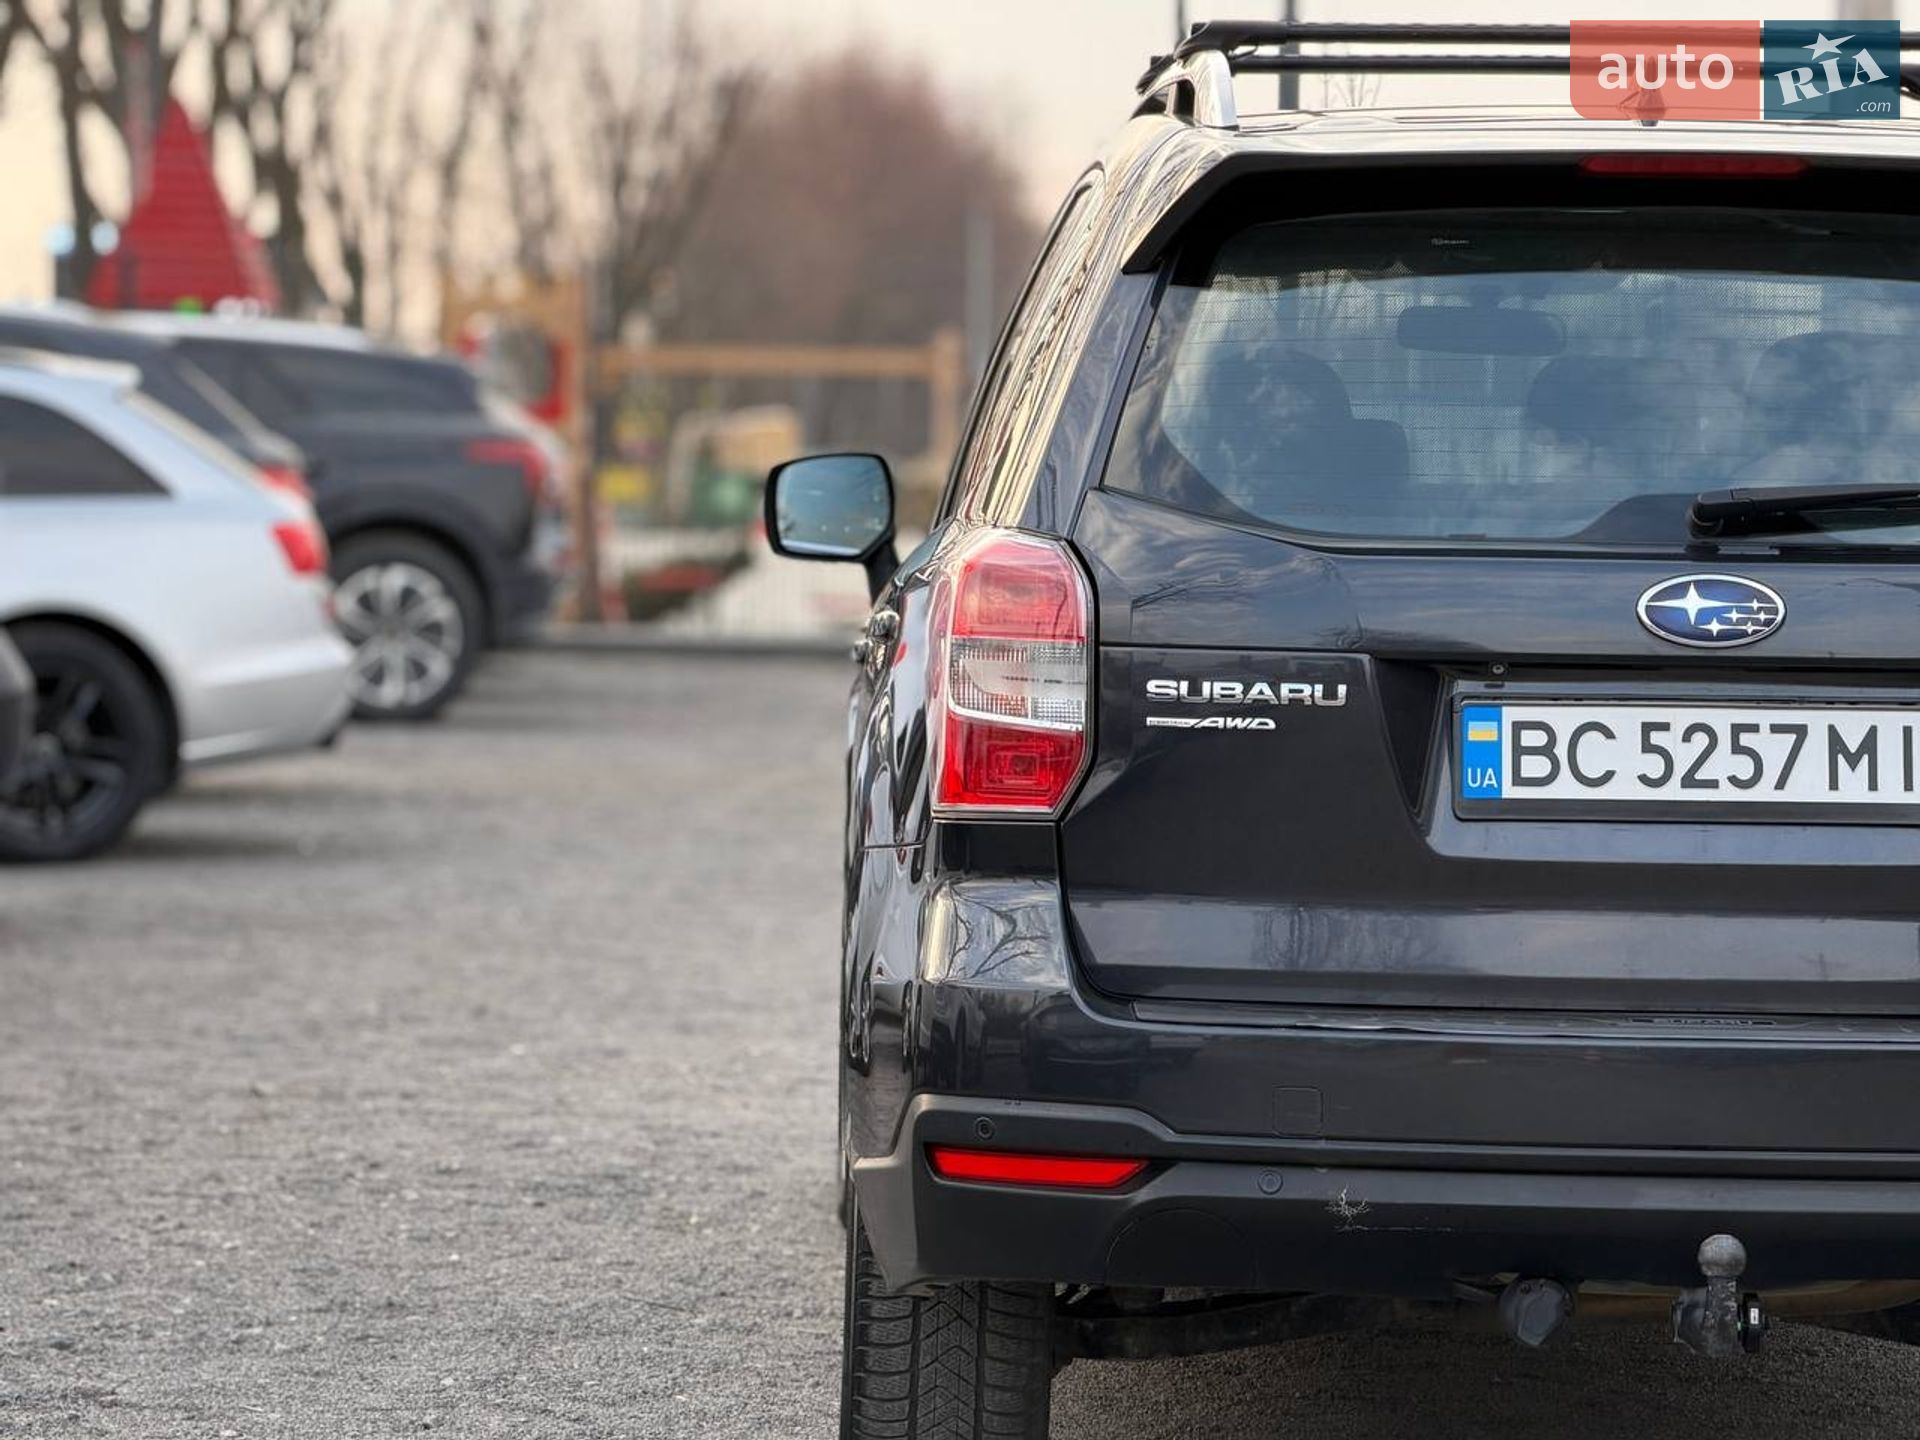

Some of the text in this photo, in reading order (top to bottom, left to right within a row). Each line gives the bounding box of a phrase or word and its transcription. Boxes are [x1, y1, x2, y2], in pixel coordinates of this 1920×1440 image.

[1146, 679, 1348, 706] SUBARU
[1195, 716, 1277, 730] AWD
[1511, 720, 1914, 792] BC 5257 MI
[1467, 767, 1498, 788] UA
